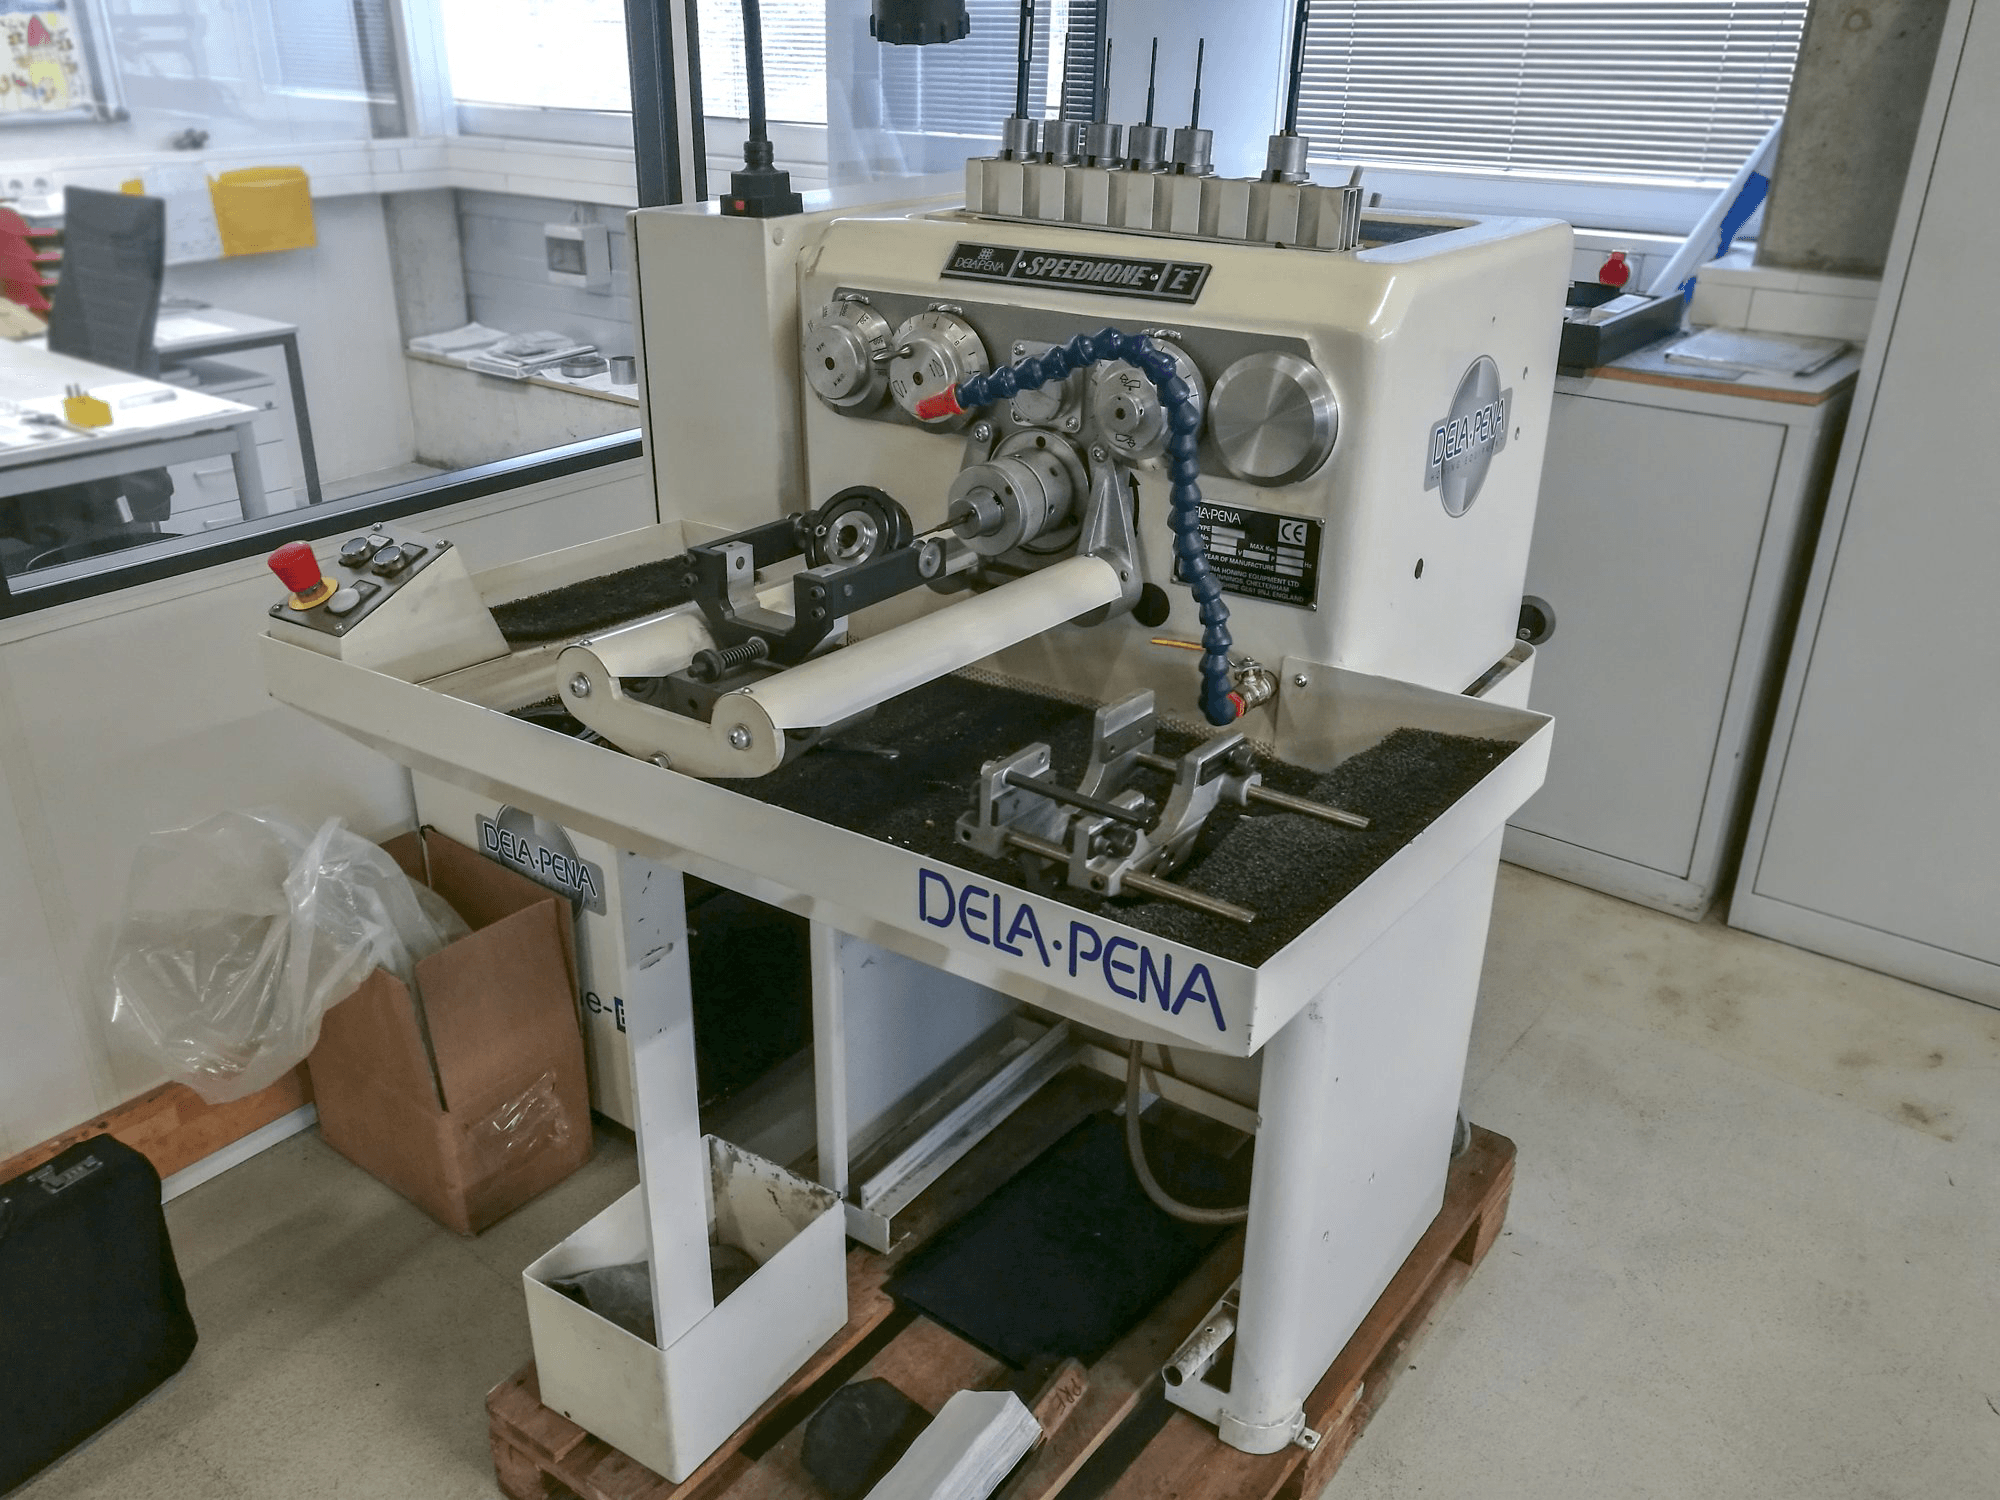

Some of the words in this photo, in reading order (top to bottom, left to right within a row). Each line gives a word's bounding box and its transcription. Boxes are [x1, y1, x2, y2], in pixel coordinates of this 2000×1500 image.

[1026, 256, 1151, 287] SPEEDHONE
[1281, 522, 1304, 543] CE
[1204, 552, 1219, 560] YEAR
[1229, 557, 1274, 571] MANUFACTURE
[1221, 567, 1247, 577] HONING
[1248, 573, 1286, 585] EQUIPMENT
[1287, 580, 1300, 588] LTD
[1246, 579, 1290, 593] CHELTENHAM
[1272, 590, 1304, 602] ENGLAND
